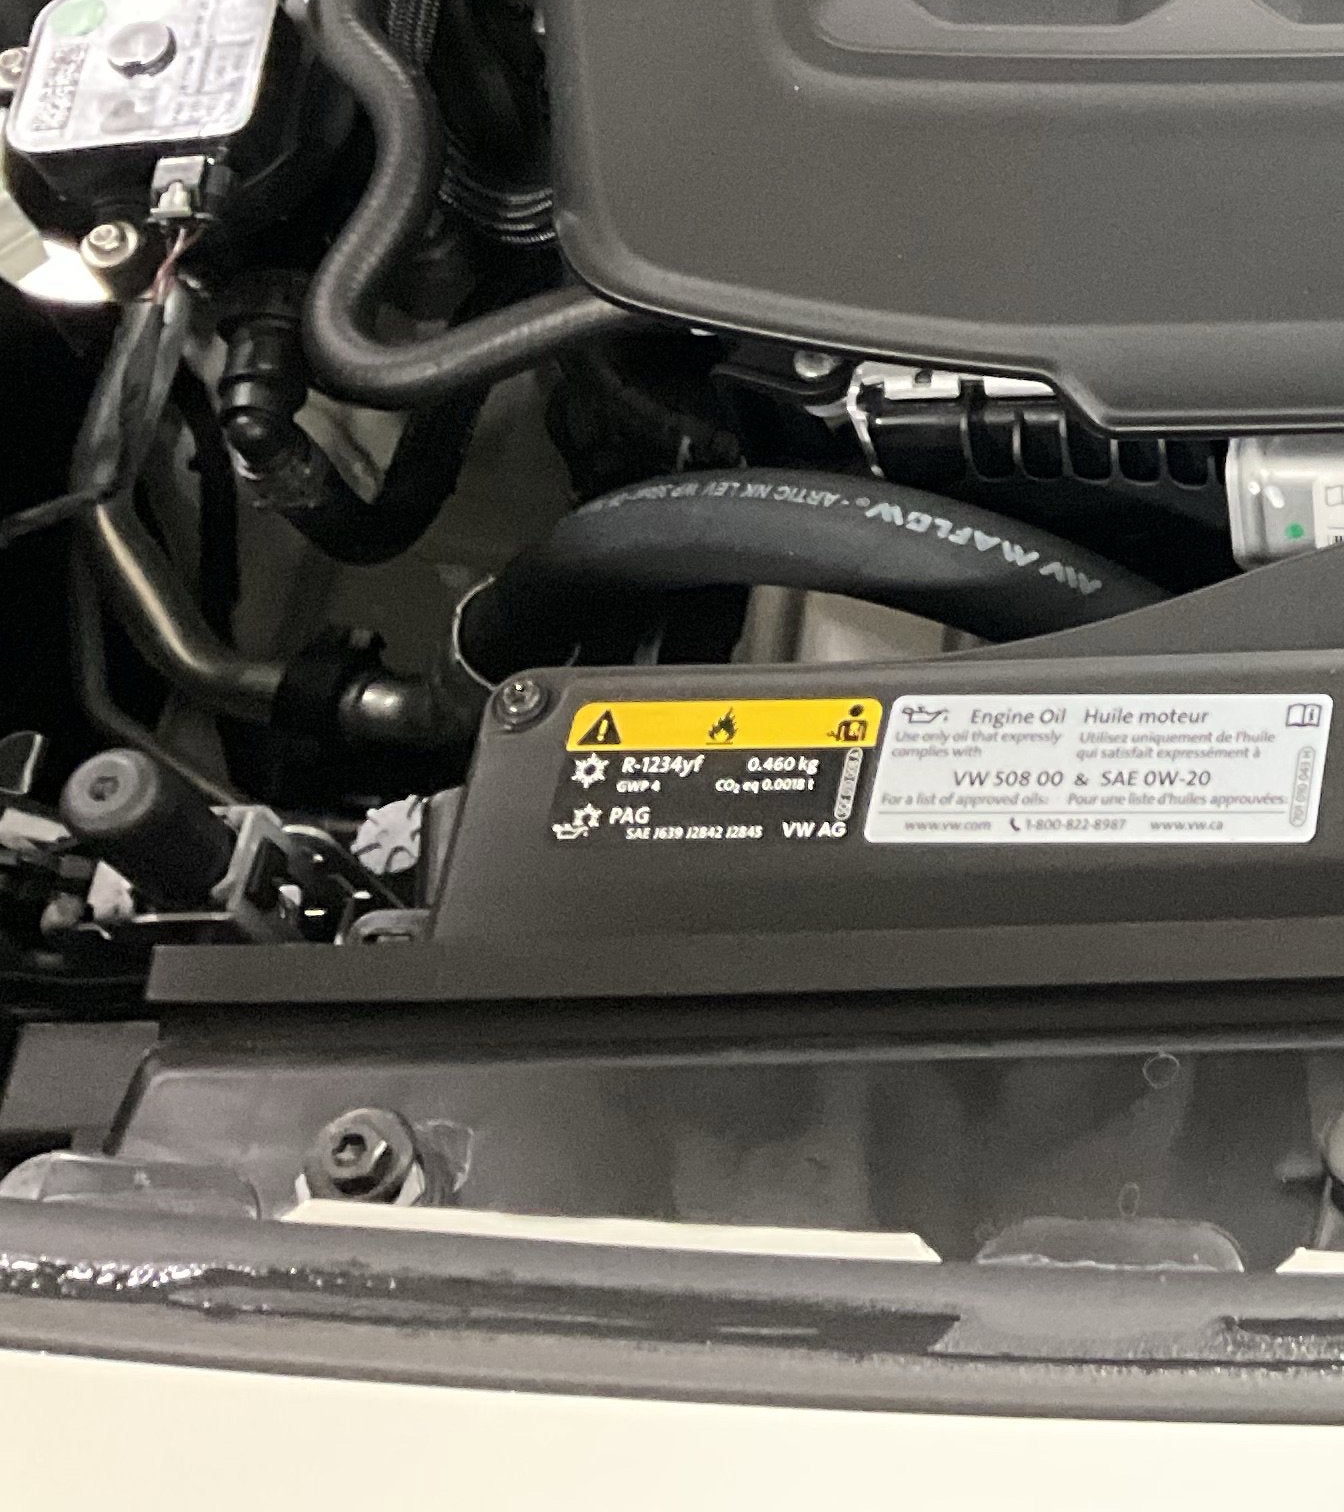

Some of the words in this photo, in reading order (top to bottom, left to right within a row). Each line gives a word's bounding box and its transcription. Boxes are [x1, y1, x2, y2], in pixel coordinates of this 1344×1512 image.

[971, 709, 1034, 729] Engine
[1039, 708, 1066, 724] Oil
[1084, 708, 1133, 724] Huile
[1139, 709, 1209, 724] moteur
[895, 731, 920, 742] Use
[922, 730, 950, 746] only
[952, 729, 969, 742] oil
[971, 729, 998, 742] that
[1001, 730, 1062, 745] expressly
[1131, 732, 1213, 746] uniquement
[1216, 731, 1232, 743] de
[1236, 730, 1275, 743] l'huile
[891, 746, 949, 760] complies
[952, 746, 982, 757] with
[1076, 748, 1098, 762] qui
[1253, 746, 1261, 758] à
[622, 754, 705, 775] R-1234yf
[747, 756, 796, 773] 0.460
[798, 756, 819, 776] kg
[954, 771, 990, 786] VW
[994, 771, 1031, 786] 508
[1036, 770, 1064, 787] 00
[1074, 773, 1088, 786] &
[1101, 771, 1138, 786] SAE
[1144, 770, 1211, 786] 0W-20
[881, 793, 903, 805] For
[905, 795, 913, 805] a
[916, 792, 936, 805] list
[939, 792, 954, 805] of
[956, 793, 1020, 808] approved
[1067, 793, 1098, 805] Pour
[1101, 796, 1126, 805] une
[1128, 792, 1155, 805] liste
[1157, 792, 1207, 805] d'huiles
[609, 807, 651, 825] PAG
[782, 822, 816, 839] VW
[817, 821, 848, 838] AG
[905, 821, 991, 831] www.vw.com
[1026, 819, 1126, 830] 1-800-822-8987
[1150, 821, 1223, 831] www.vw.ca
[626, 827, 651, 840] SAE
